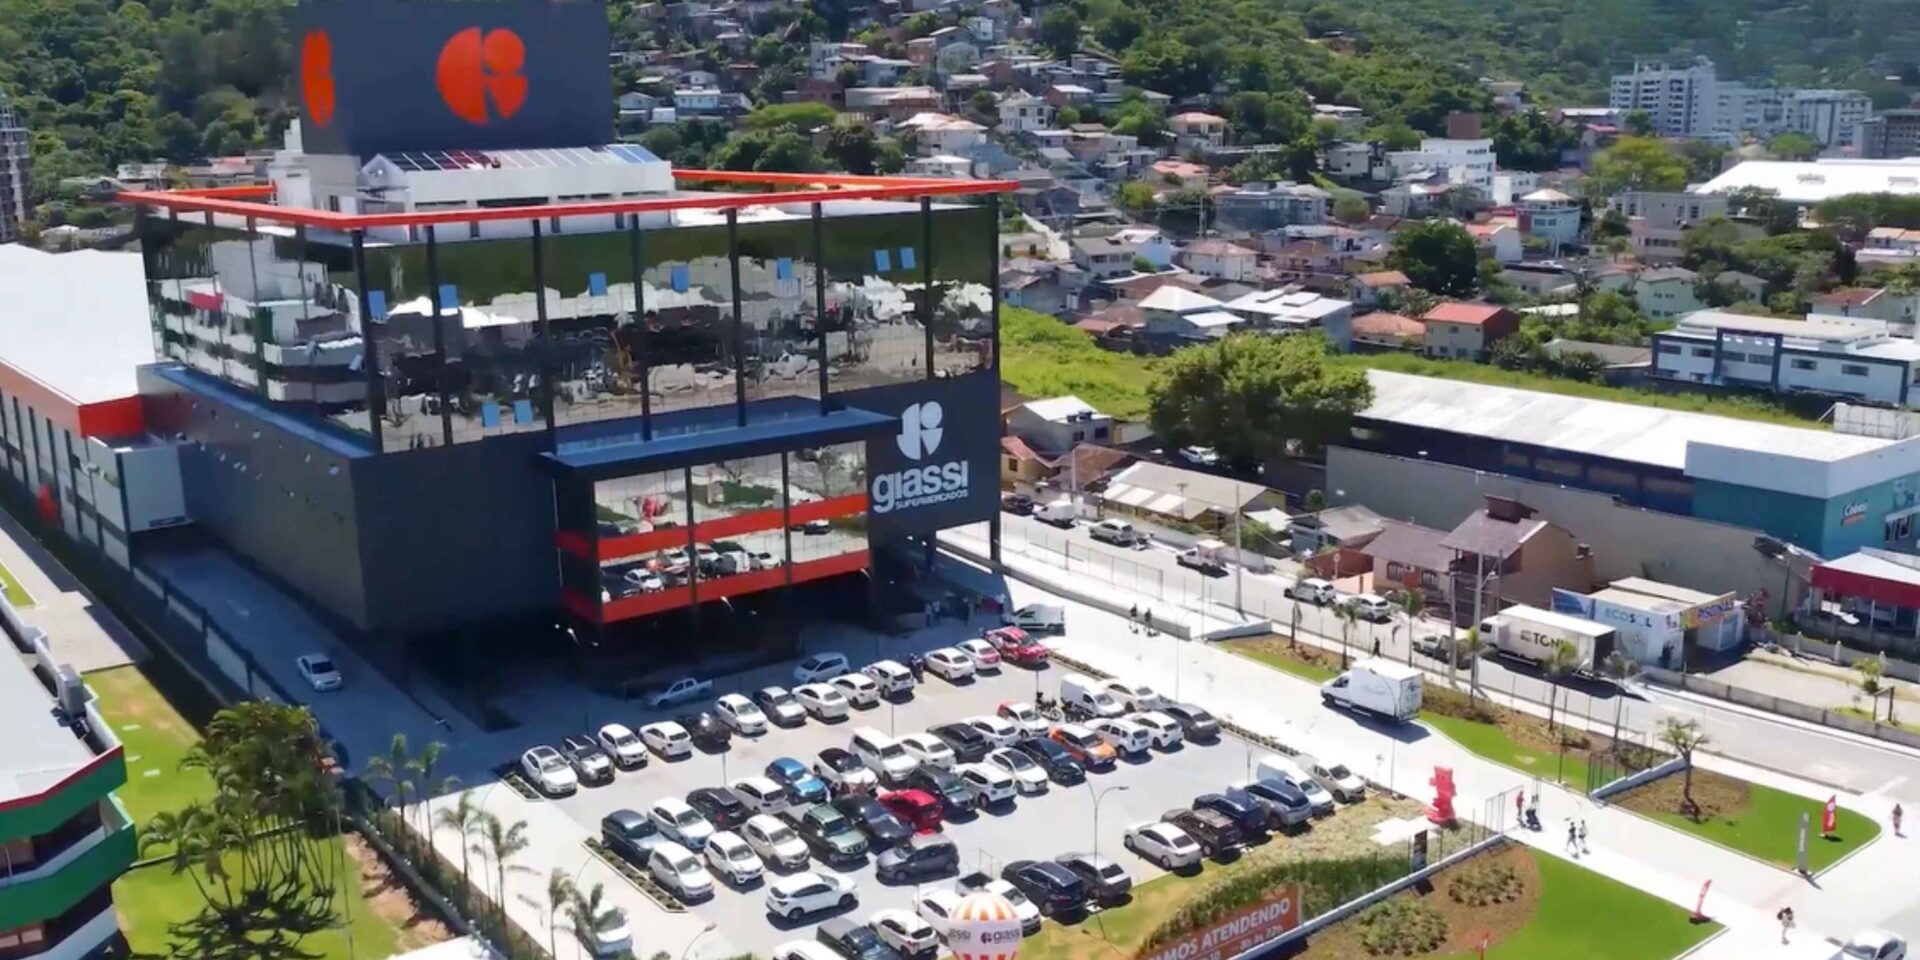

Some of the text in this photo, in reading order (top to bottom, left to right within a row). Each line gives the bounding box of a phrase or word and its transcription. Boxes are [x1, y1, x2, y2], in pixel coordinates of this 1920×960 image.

[872, 459, 968, 513] giassi
[895, 489, 968, 511] SUPERMERCADOS
[1201, 897, 1291, 951] ATENDENDO
